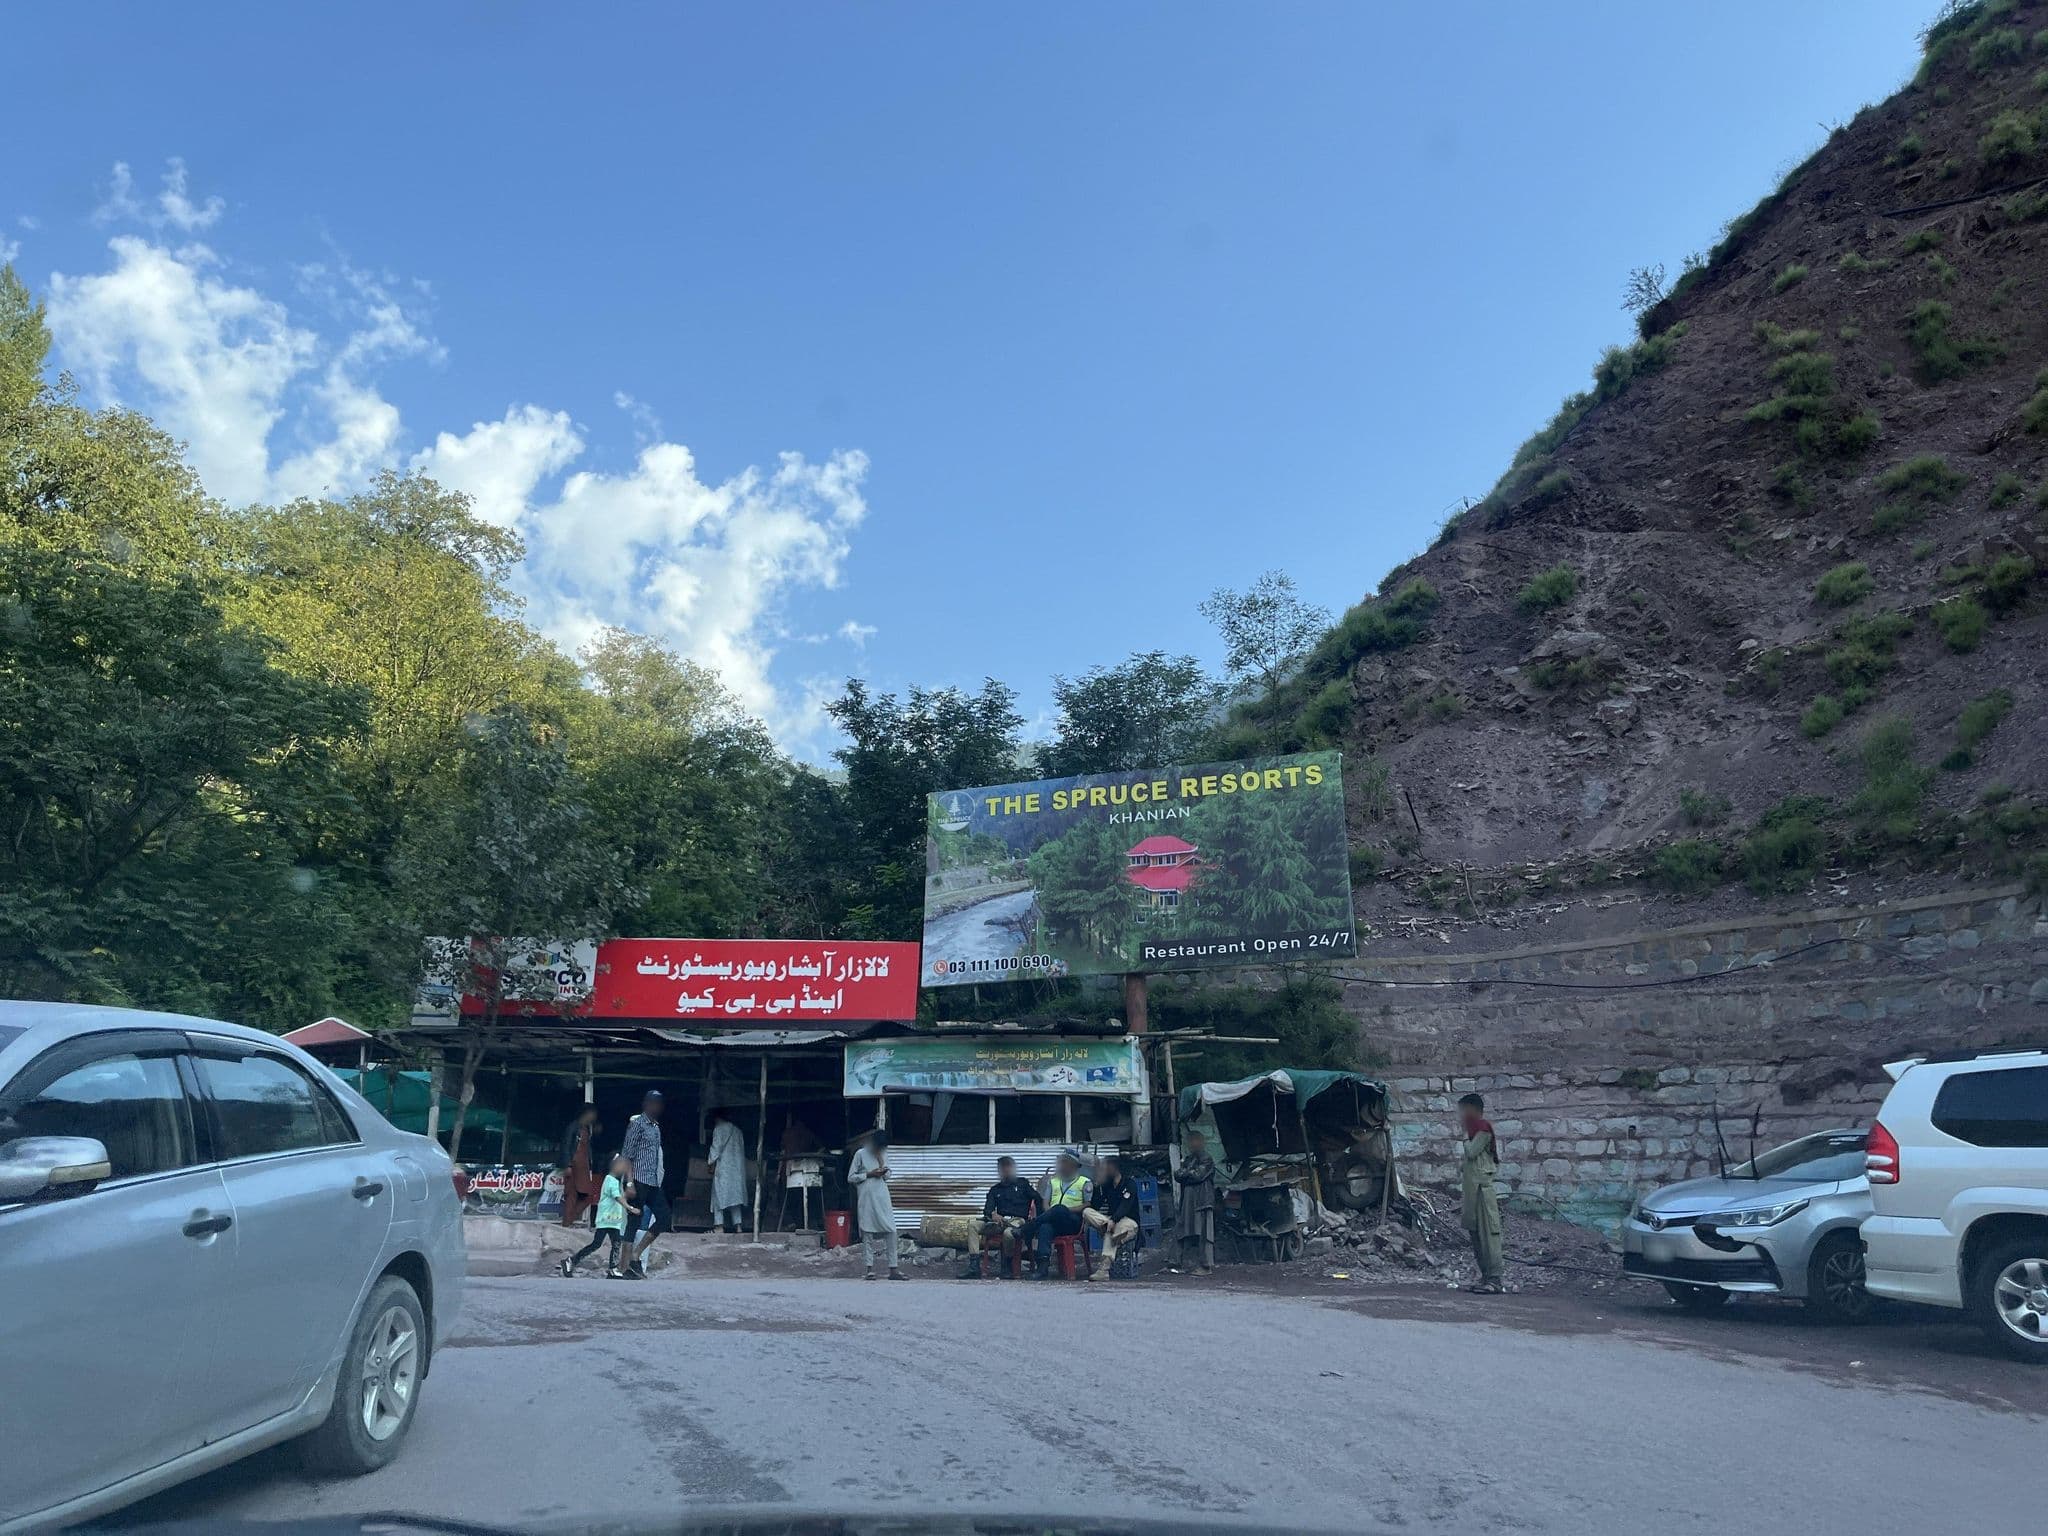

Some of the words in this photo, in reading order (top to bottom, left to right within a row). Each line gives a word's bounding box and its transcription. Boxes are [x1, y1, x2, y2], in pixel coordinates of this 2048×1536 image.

[986, 794, 1040, 816] THE
[1053, 781, 1168, 810] SPRUCE
[1181, 765, 1323, 798] RESORTS
[1109, 806, 1190, 825] KHANIAN
[1145, 941, 1246, 959] Restaurant
[1254, 938, 1300, 953] Open
[1308, 932, 1350, 948] 24/7
[949, 961, 966, 974] 03
[970, 959, 989, 972] 111
[994, 957, 1018, 970] 100
[1022, 955, 1051, 969] 690
